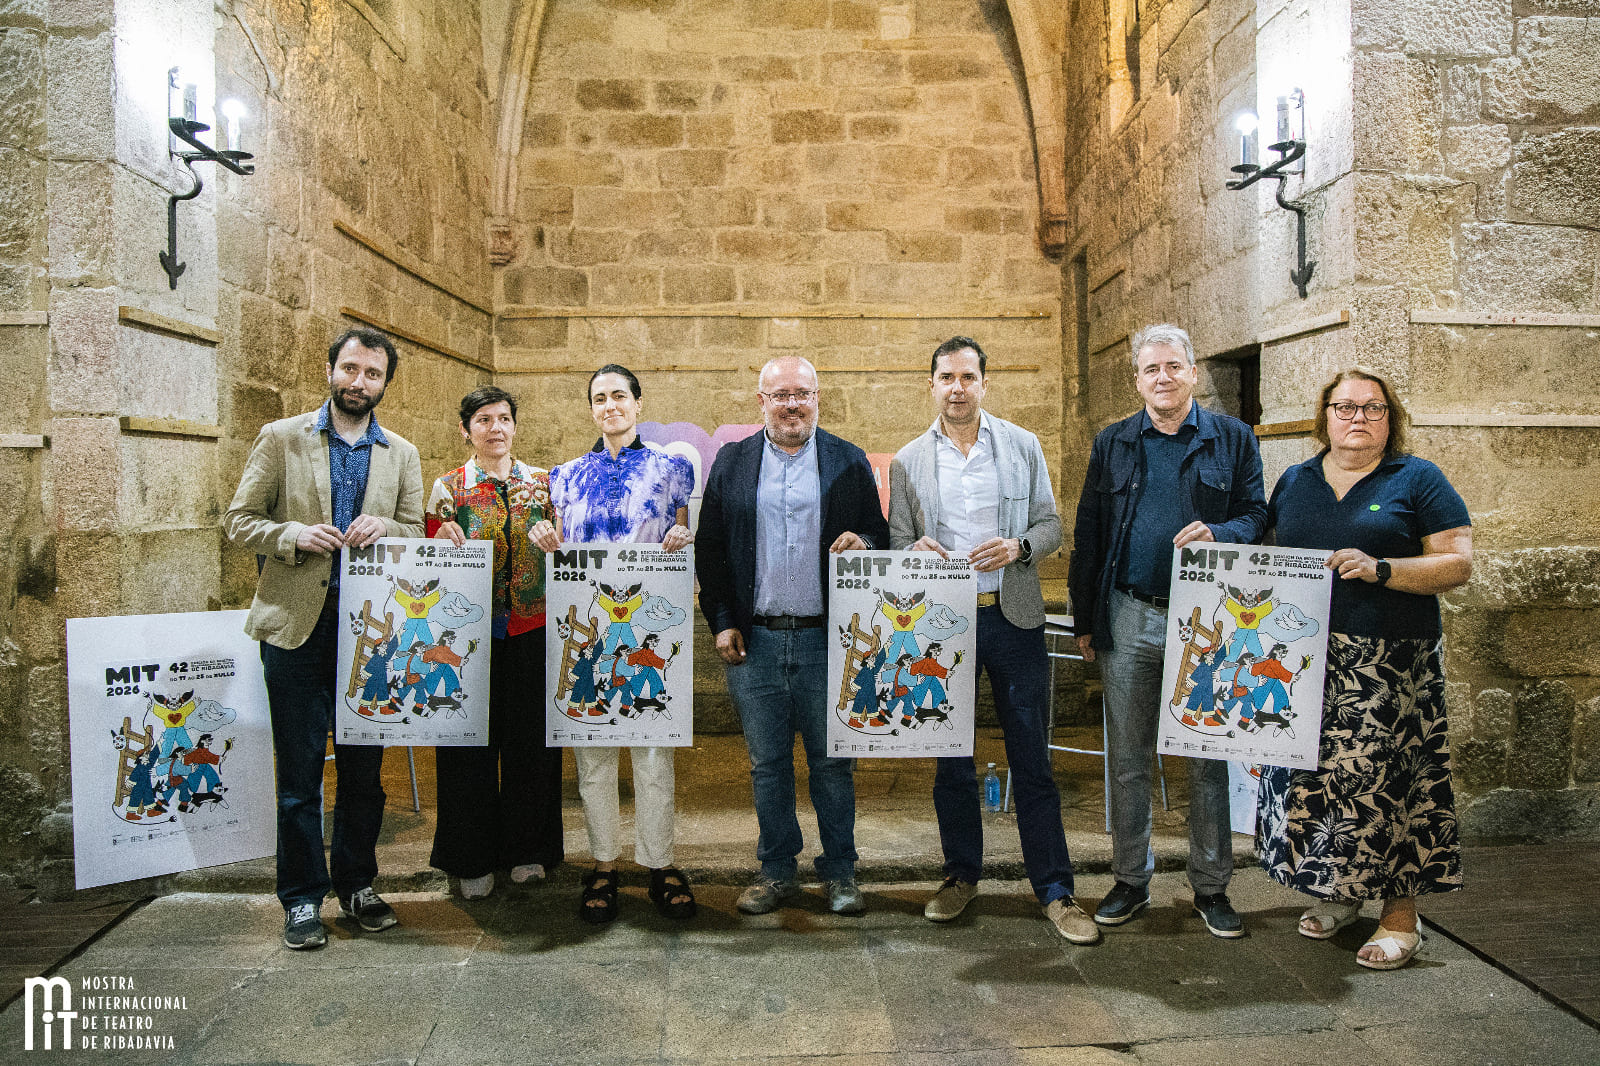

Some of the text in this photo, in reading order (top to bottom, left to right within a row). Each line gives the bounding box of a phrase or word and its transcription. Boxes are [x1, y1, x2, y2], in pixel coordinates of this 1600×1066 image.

[349, 544, 406, 564] MIT
[416, 545, 436, 558] 42
[618, 550, 638, 562] 42
[554, 550, 608, 569] MIT
[902, 558, 922, 570] 42
[1180, 548, 1240, 570] MIT
[1249, 552, 1270, 566] 42
[348, 565, 384, 576] 2026
[836, 557, 892, 576] MIT
[554, 571, 586, 582] 2026
[1178, 570, 1215, 582] 2026
[836, 579, 870, 589] 2026
[169, 662, 188, 673] 42
[106, 664, 160, 685] MIT
[106, 685, 140, 697] 2026
